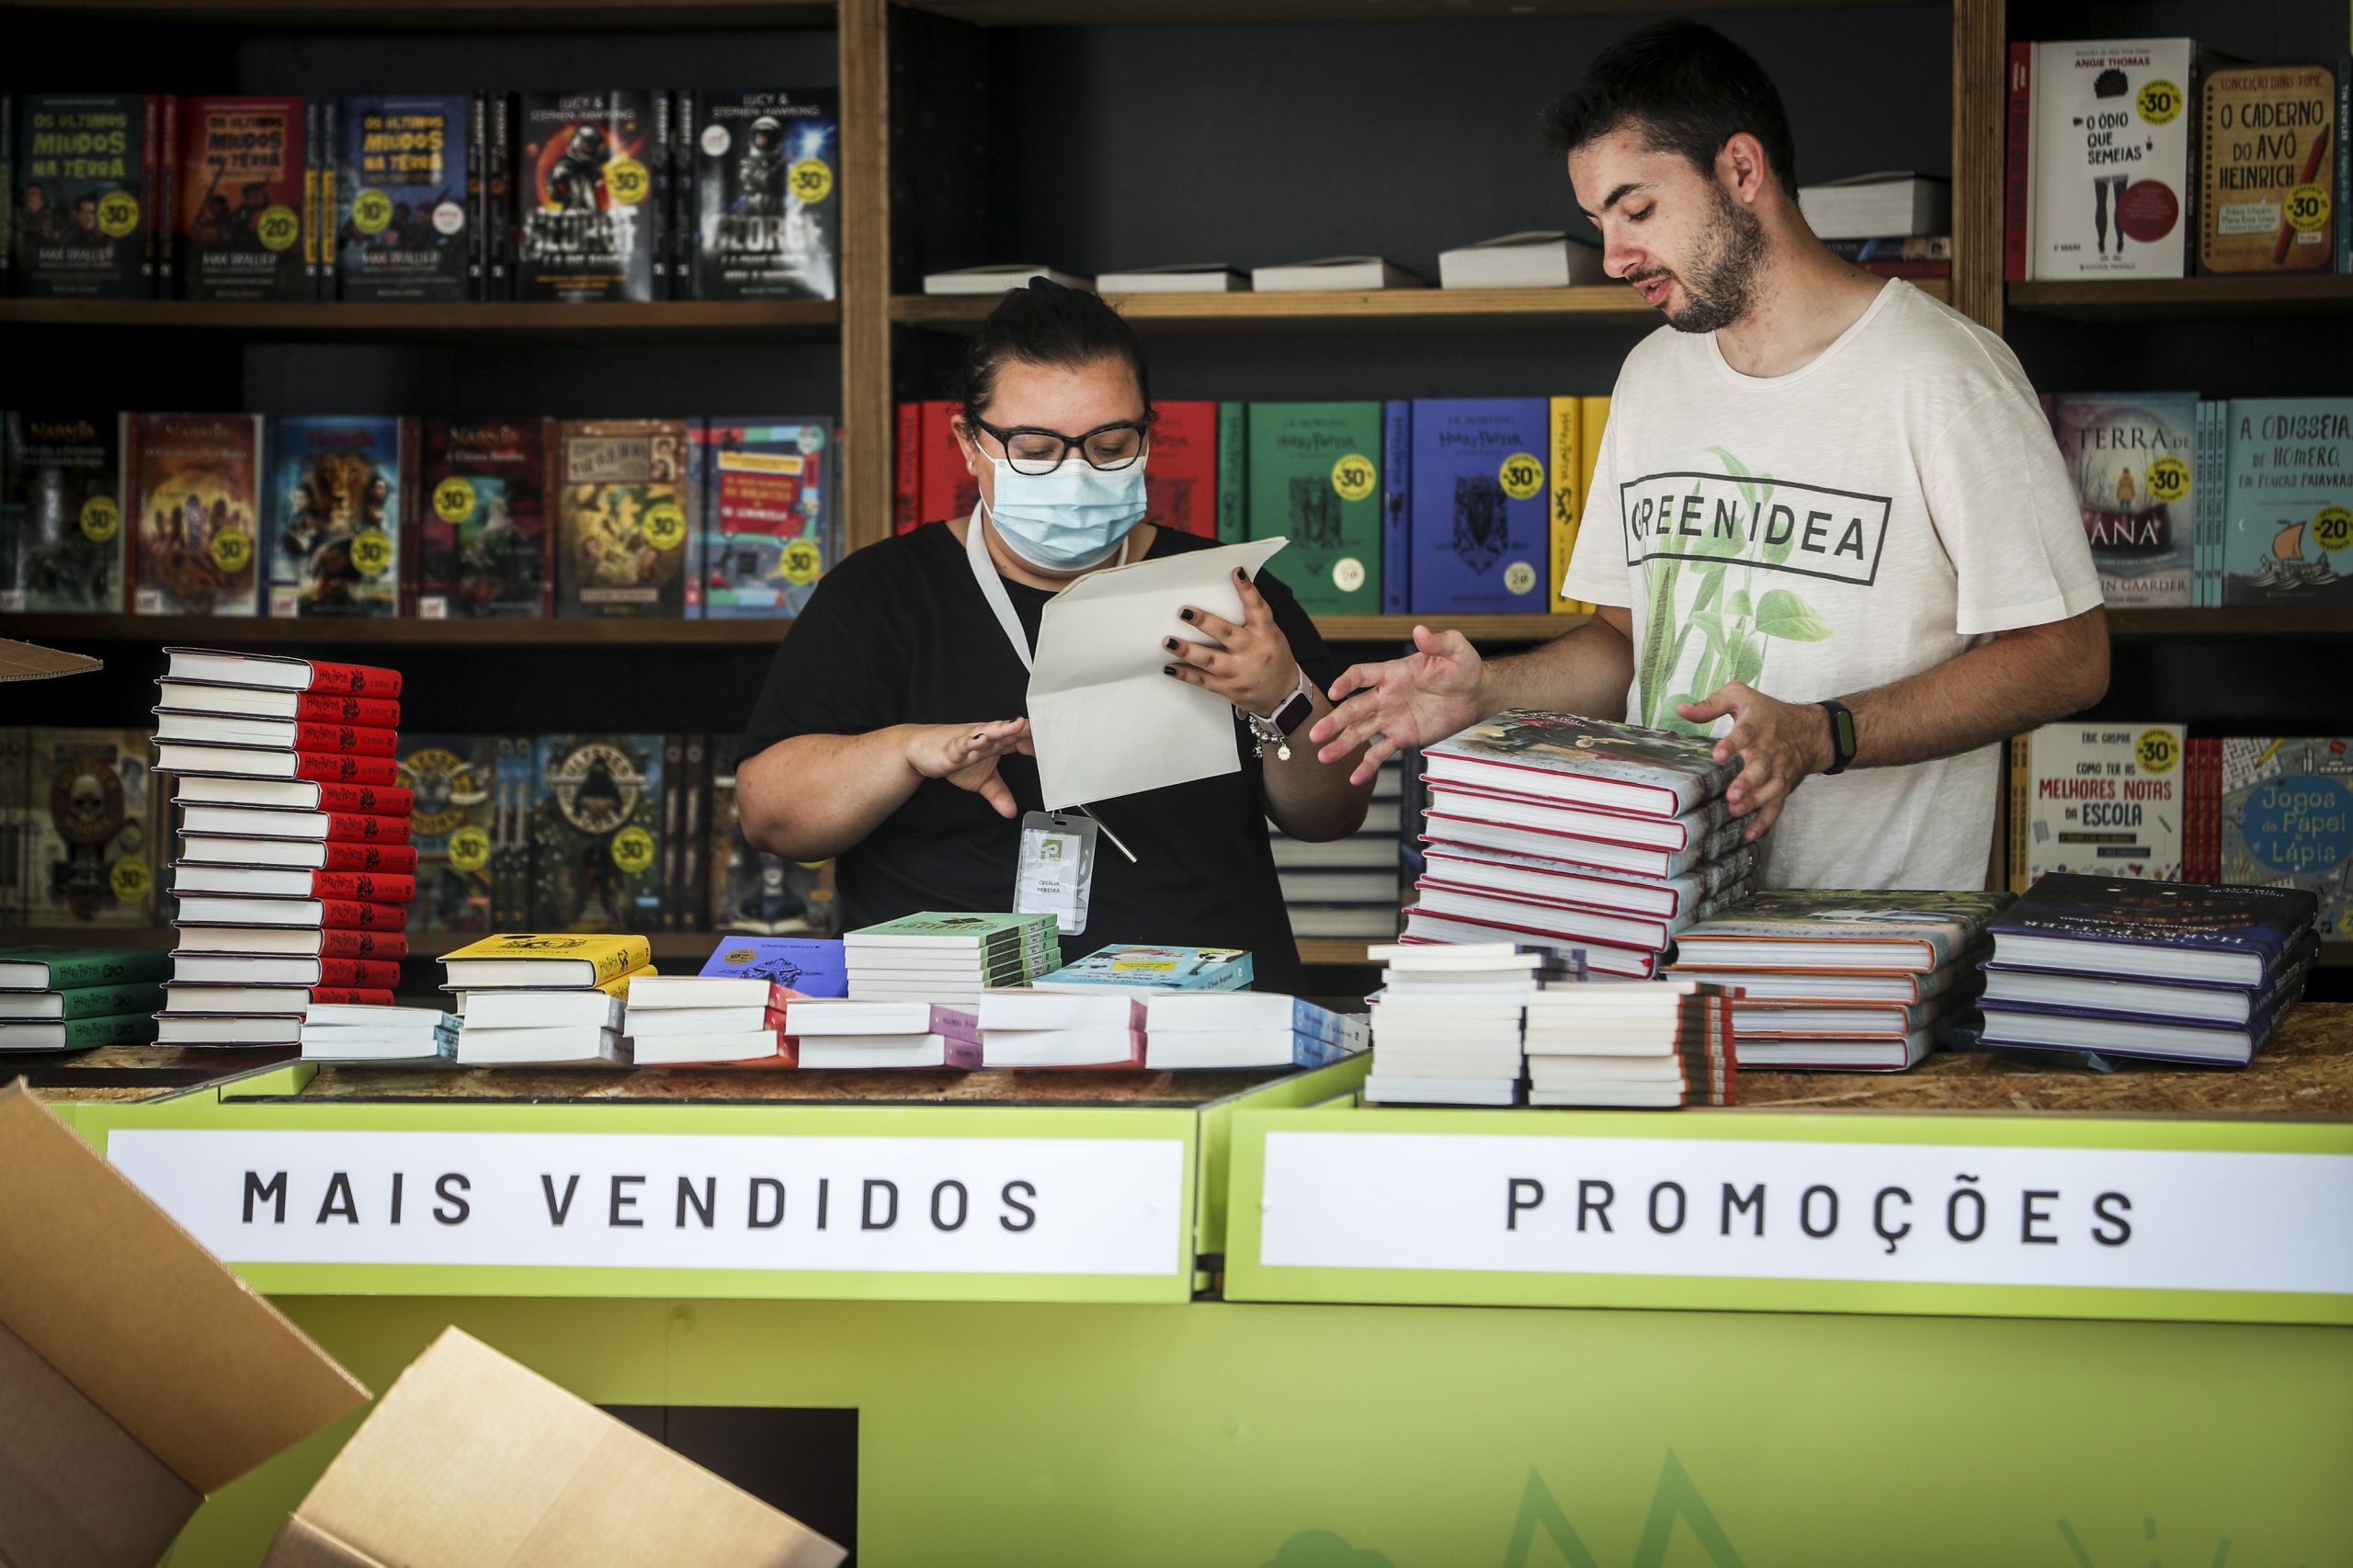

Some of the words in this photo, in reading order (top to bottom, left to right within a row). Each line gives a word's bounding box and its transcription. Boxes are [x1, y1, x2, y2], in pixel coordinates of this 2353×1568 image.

[2075, 59, 2105, 69] ANGIE
[2109, 57, 2151, 68] THOMAS
[2086, 116, 2095, 130] O
[2221, 104, 2233, 131] O
[2241, 100, 2324, 129] CADERNO
[2087, 131, 2113, 148] QUE
[2233, 142, 2251, 163] DO
[2256, 128, 2296, 161] AVÔ
[2088, 146, 2142, 165] SEMEIAS
[2220, 165, 2295, 191] HEINRICH
[2075, 426, 2169, 450] TERRA
[2172, 435, 2189, 449] DE
[2240, 416, 2252, 441] A
[1748, 501, 1865, 561] IDEA
[2090, 518, 2160, 546] ANA
[2120, 579, 2187, 593] GAARDER
[2082, 731, 2098, 744] ERIC
[2101, 731, 2131, 744] GASPAR
[2076, 763, 2102, 776] COMO
[2107, 763, 2120, 776] TER
[2125, 764, 2136, 776] AS
[2039, 778, 2116, 801] MELHORES
[2124, 778, 2173, 801] NOTAS
[2262, 786, 2336, 815] Jogos
[2083, 802, 2143, 827] ESCOLA
[2283, 811, 2346, 839] Papel
[2272, 840, 2336, 869] Lápis
[2021, 919, 2134, 936] POTTER
[2147, 930, 2245, 945] HARRY
[243, 1171, 470, 1225] MAIS
[540, 1174, 1037, 1233] VENDIDOS
[1506, 1173, 2132, 1254] PROMOÇÕES
